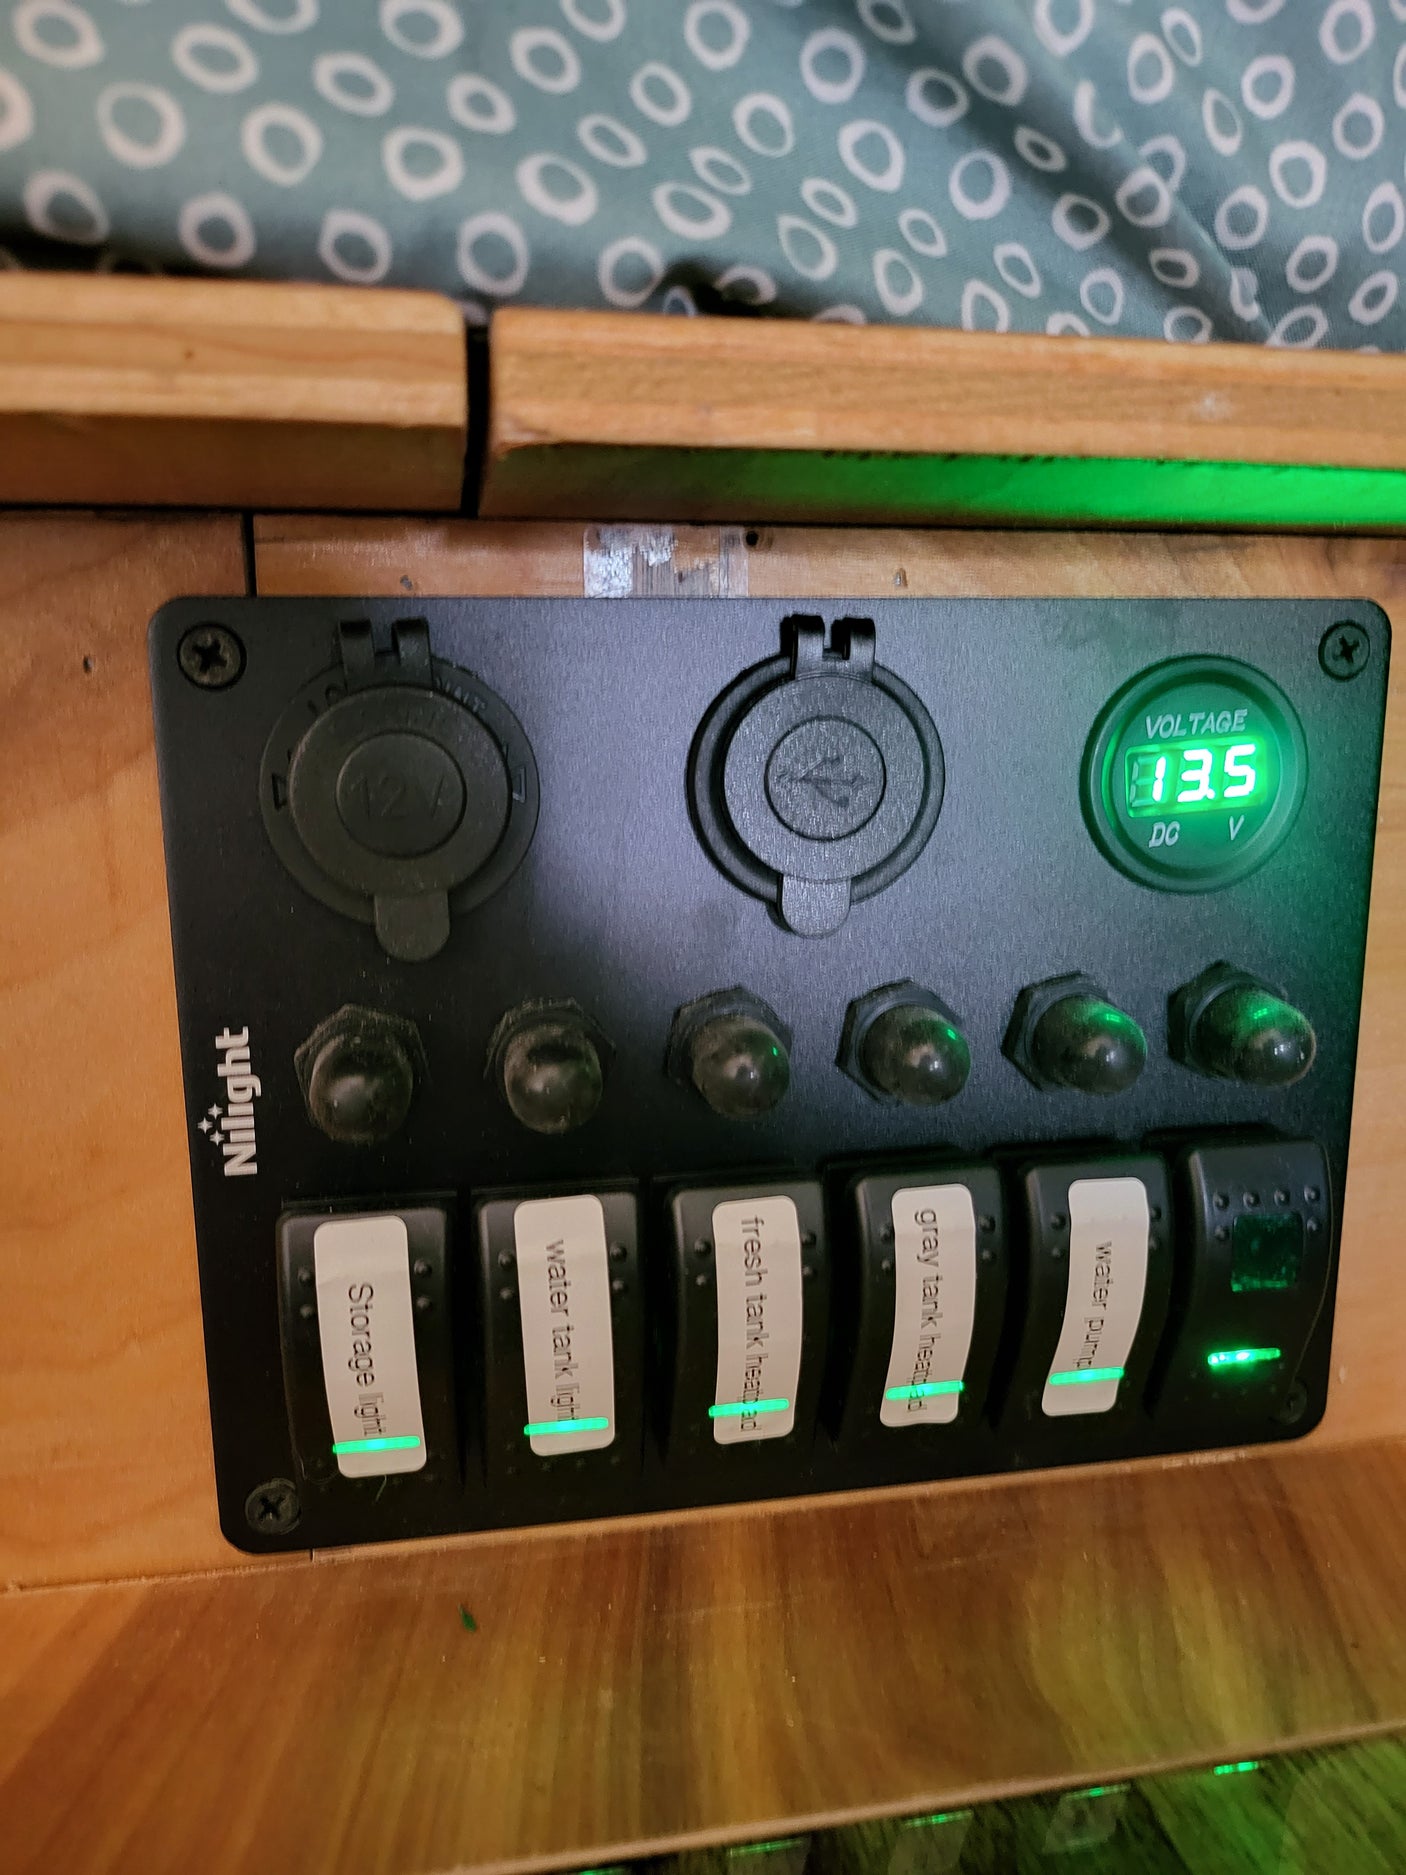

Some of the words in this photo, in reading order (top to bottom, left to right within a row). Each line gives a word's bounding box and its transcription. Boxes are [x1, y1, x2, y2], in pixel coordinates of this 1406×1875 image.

[1145, 708, 1248, 740] VOLTAGE
[1151, 743, 1256, 803] 13.5
[1148, 820, 1181, 848] DC
[1228, 814, 1245, 841] V
[214, 1025, 262, 1177] Nilight
[741, 1216, 767, 1287] fresh
[914, 1207, 941, 1268] gray
[546, 1239, 572, 1316] water
[920, 1274, 945, 1330] tank
[1091, 1241, 1113, 1309] water
[348, 1282, 375, 1387] Storage
[746, 1293, 770, 1350] tank
[552, 1324, 582, 1380] tank
[353, 1392, 386, 1436] light
